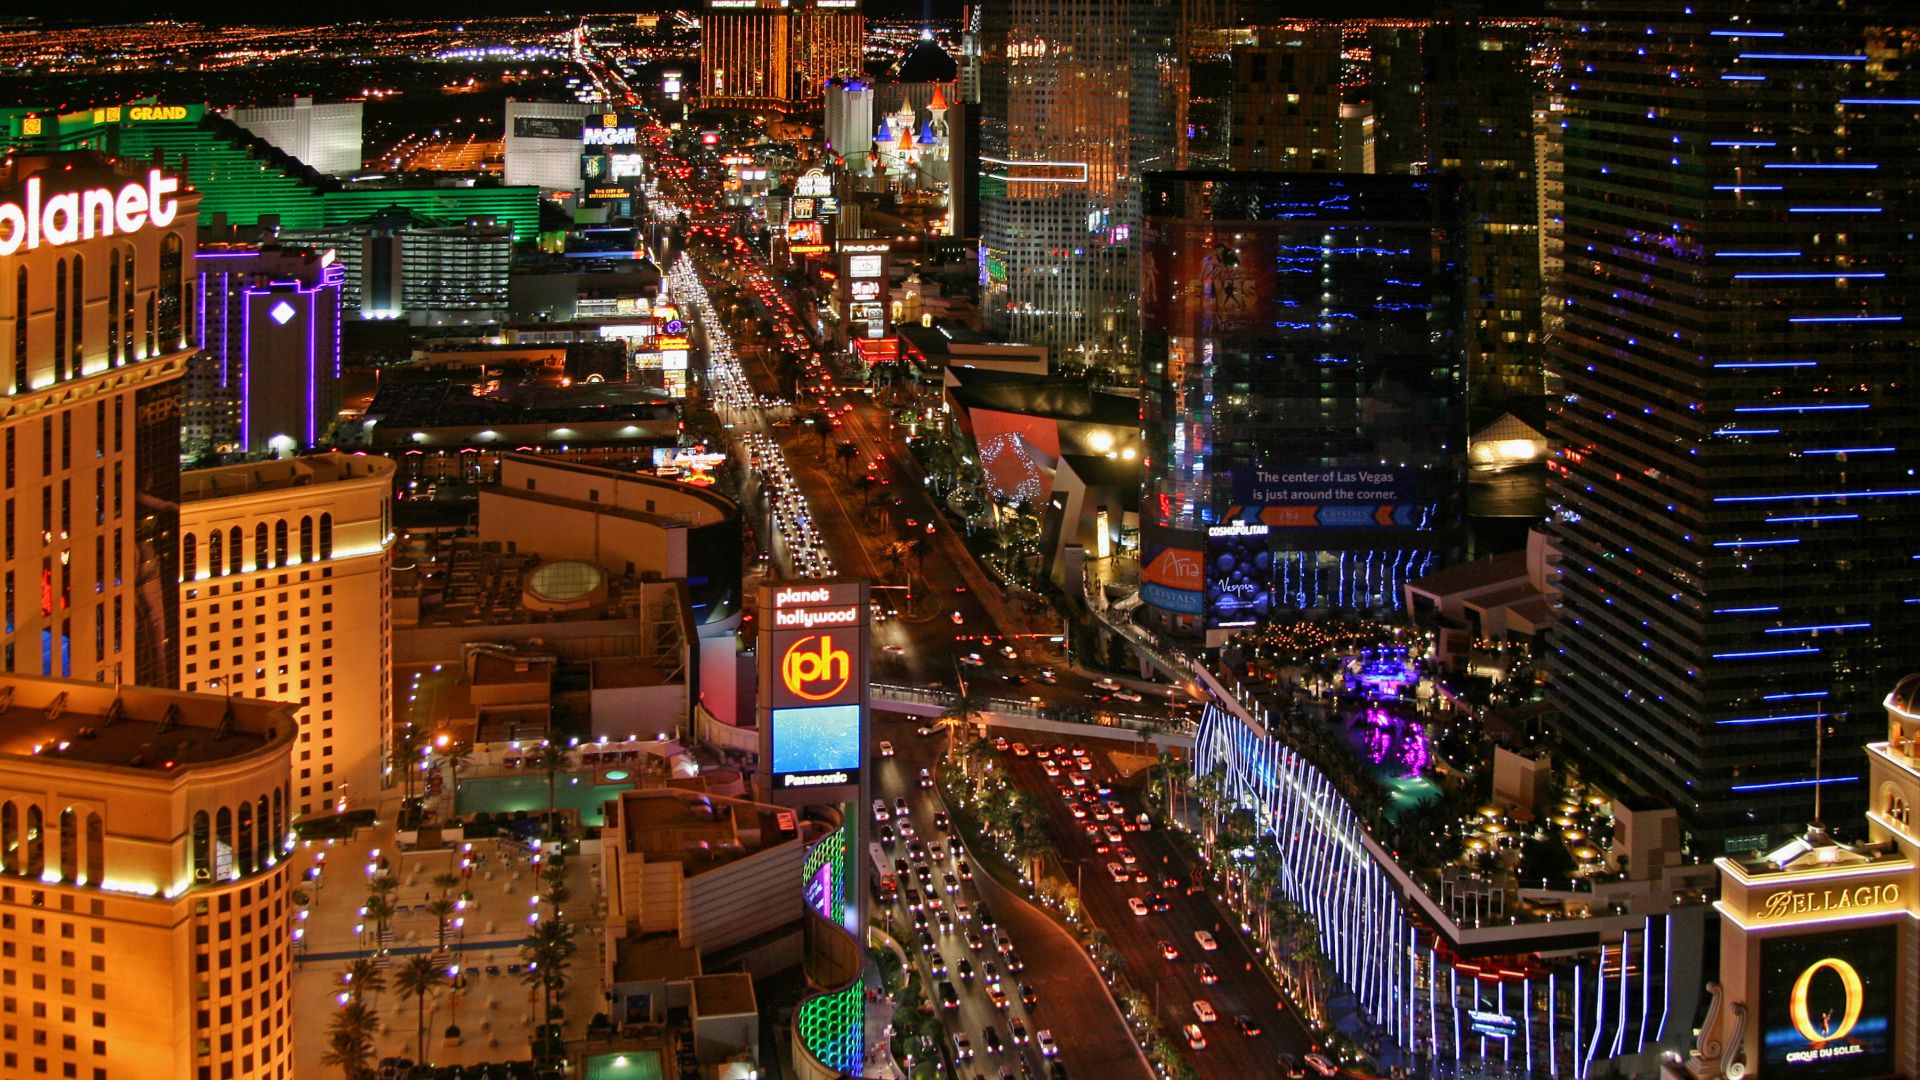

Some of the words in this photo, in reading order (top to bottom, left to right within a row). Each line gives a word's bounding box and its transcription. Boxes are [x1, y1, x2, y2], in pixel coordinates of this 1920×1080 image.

[129, 106, 187, 121] GRAND
[583, 128, 637, 145] MGM
[1256, 471, 1279, 482] The
[1282, 472, 1319, 482] center
[1322, 471, 1334, 482] of
[1337, 471, 1356, 482] Las
[1358, 471, 1394, 484] Vegas
[1252, 489, 1263, 500] is
[1265, 489, 1289, 502] just
[1290, 489, 1332, 500] around
[1335, 489, 1354, 500] the
[1357, 489, 1397, 500] corner.
[1208, 525, 1268, 536] COSMOPOLITAN
[1162, 551, 1200, 577] Aria
[776, 586, 830, 607] planet
[776, 607, 856, 627] hollywood
[790, 635, 850, 692] ph
[784, 772, 848, 787] Panasonic
[1756, 883, 1900, 919] BELLAGIO
[1786, 1050, 1818, 1062] CIRQUE
[1819, 1048, 1833, 1058] DU
[1833, 1044, 1864, 1056] SOLEIL
